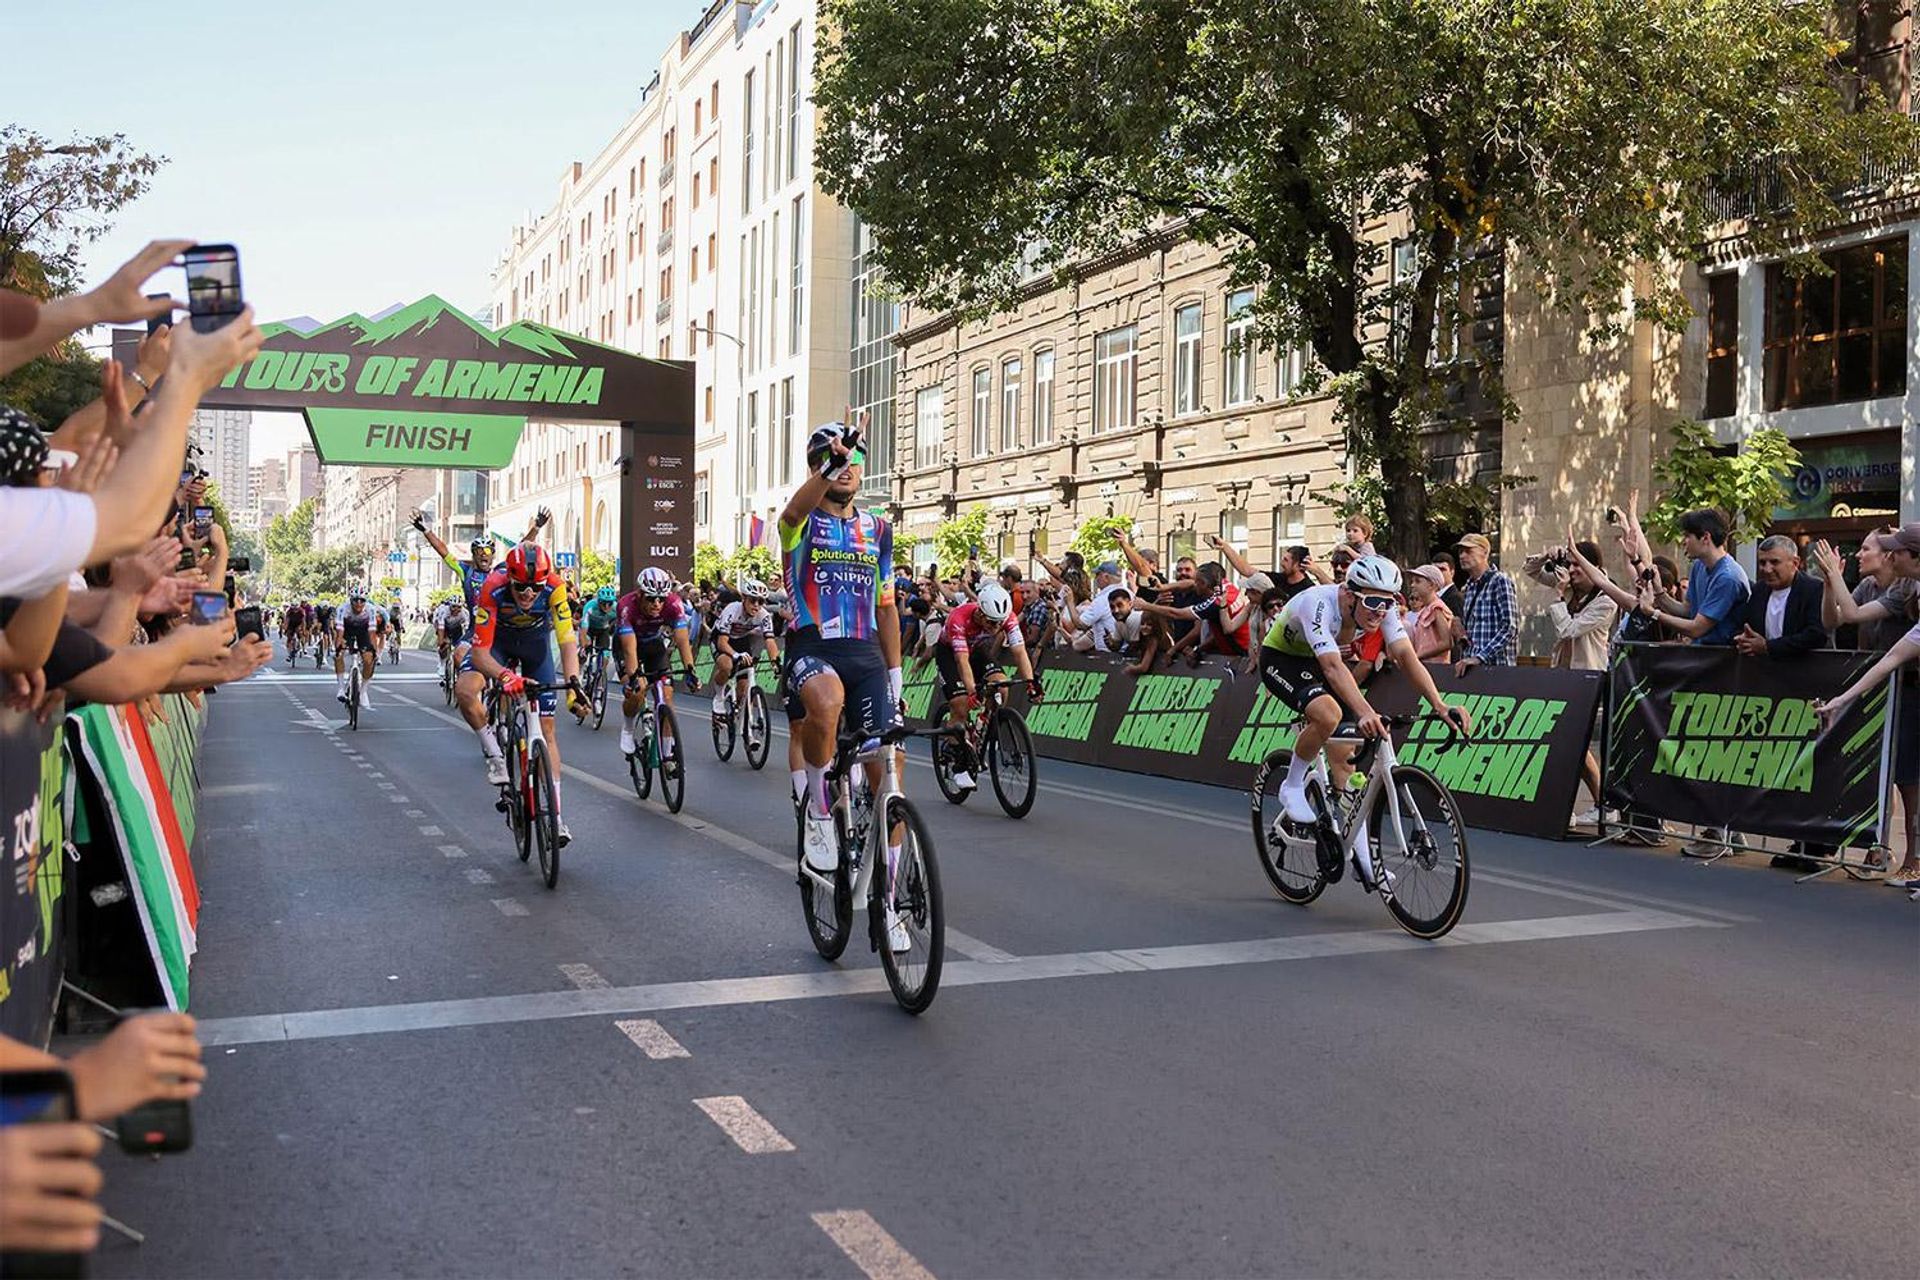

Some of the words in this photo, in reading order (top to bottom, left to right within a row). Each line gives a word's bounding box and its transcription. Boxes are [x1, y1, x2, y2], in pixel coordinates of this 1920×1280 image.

[355, 356, 419, 396] OF
[411, 359, 605, 405] ARMENIA
[365, 424, 472, 451] FINISH
[811, 547, 855, 564] Solution
[833, 571, 872, 586] NIPPO
[1127, 674, 1191, 712] TOUR
[1184, 678, 1222, 709] OF
[1112, 711, 1210, 755] ARMENIA
[1503, 699, 1567, 740] OF
[1666, 692, 1773, 737] TOUR
[1767, 698, 1822, 737] OF
[1651, 739, 1817, 792] ARMENIA
